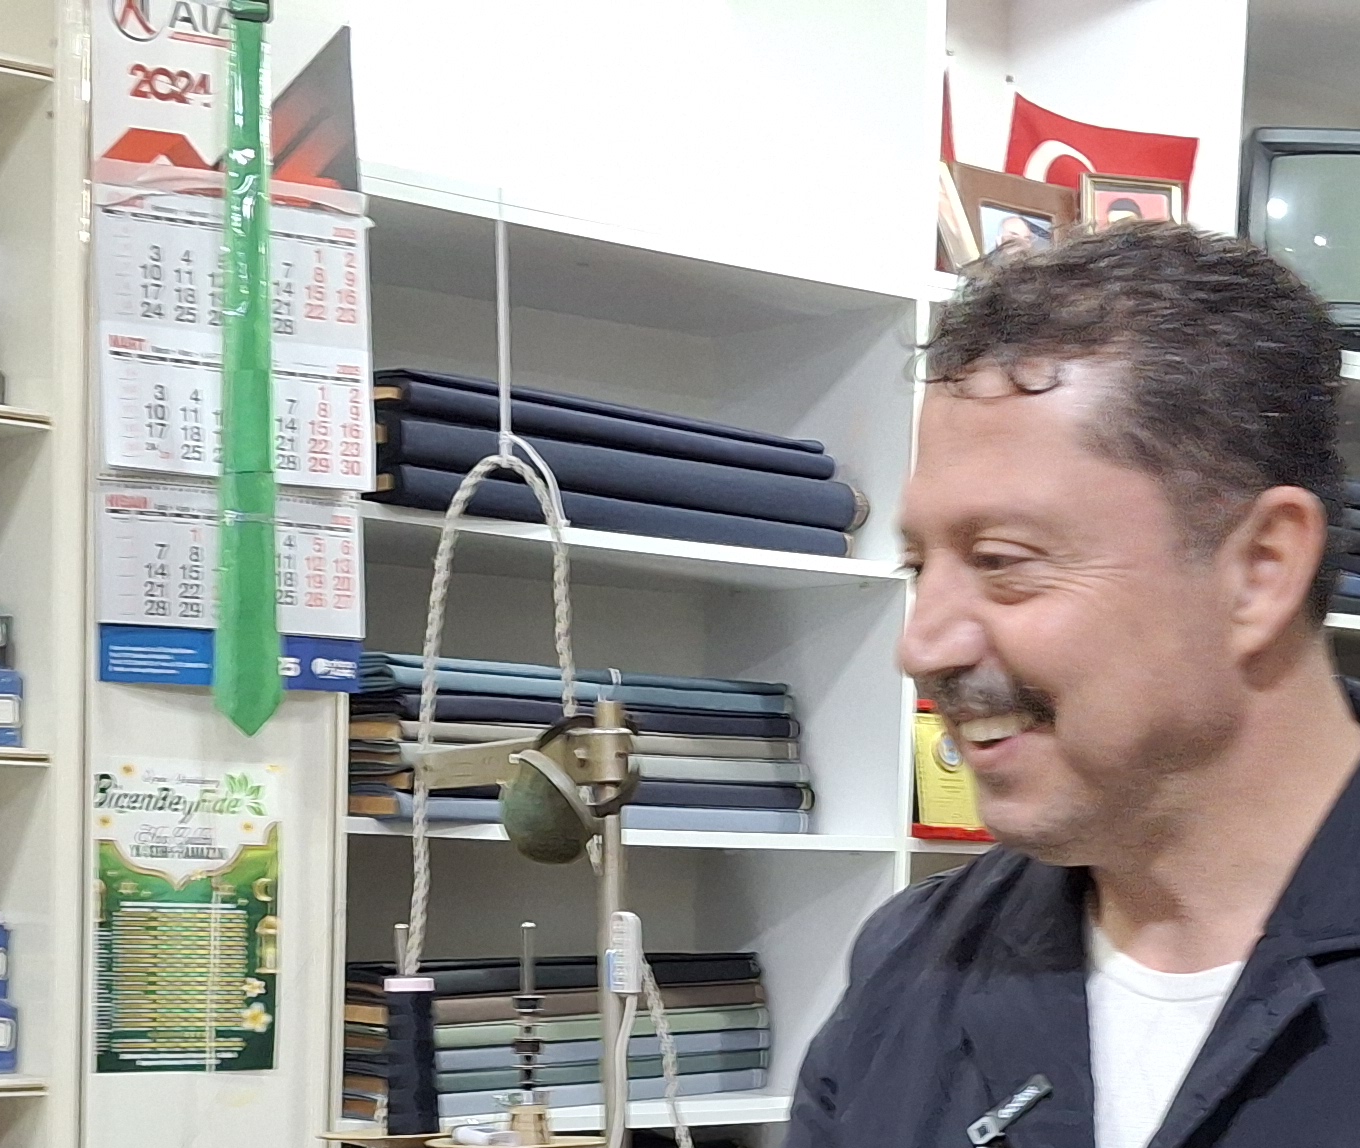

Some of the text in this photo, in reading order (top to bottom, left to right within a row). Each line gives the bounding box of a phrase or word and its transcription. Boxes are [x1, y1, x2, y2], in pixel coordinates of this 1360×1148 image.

[150, 244, 357, 288] 3 4 7 8 9
[139, 263, 163, 281] 10
[174, 268, 194, 285] 11
[272, 280, 295, 298] 14
[305, 285, 326, 302] 15
[336, 288, 357, 306] 16
[140, 282, 163, 300] 17
[174, 287, 196, 305] 18
[271, 298, 292, 316] 21
[304, 302, 326, 320] 22
[336, 306, 357, 324] 23
[140, 300, 165, 319] 24
[174, 304, 197, 324] 25
[272, 316, 295, 335] 28
[153, 383, 361, 422] 3 4 7 8 9
[349, 387, 361, 405] 2
[144, 402, 167, 421] 10
[180, 405, 200, 424] 11
[274, 416, 298, 434] 14
[308, 420, 331, 437] 15
[339, 423, 361, 441] 16
[145, 420, 167, 439] 17
[180, 424, 203, 443] 18
[275, 434, 297, 453] 21
[307, 437, 332, 456] 22
[340, 440, 362, 458] 23
[180, 442, 205, 462] 25
[275, 453, 300, 472] 28
[307, 456, 331, 474] 29
[340, 459, 362, 477] 30
[154, 542, 169, 560] 7
[188, 545, 203, 563] 8
[276, 552, 295, 570] 11
[282, 534, 295, 551] 4
[313, 536, 326, 553] 5
[342, 540, 354, 556] 6
[143, 562, 168, 580] 14
[178, 564, 204, 581] 15
[276, 569, 297, 588] 18
[143, 580, 166, 598] 21
[178, 582, 203, 600] 22
[275, 588, 298, 606] 25
[144, 599, 204, 618] 28 29
